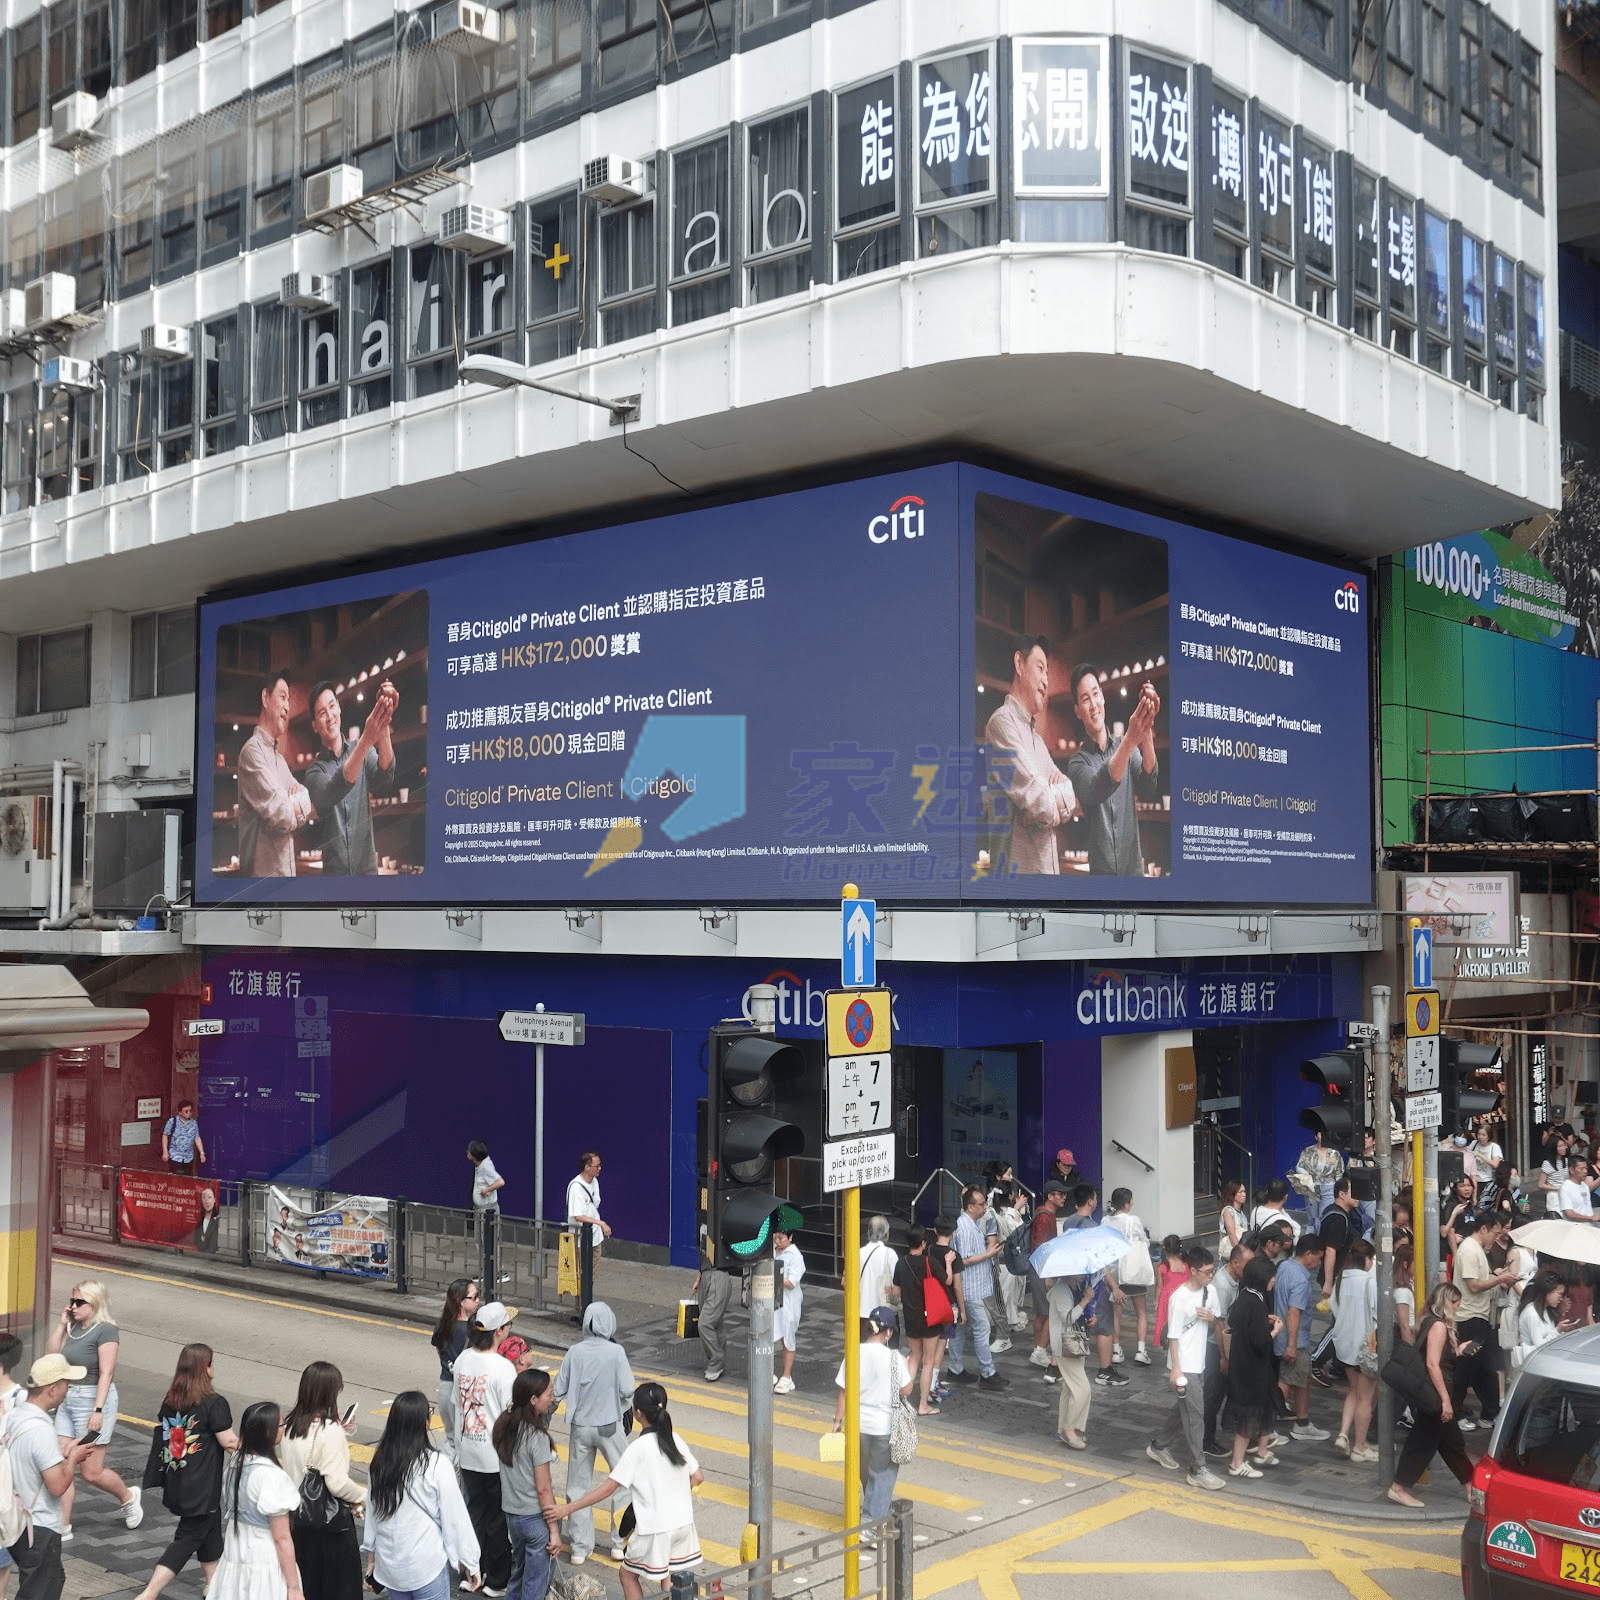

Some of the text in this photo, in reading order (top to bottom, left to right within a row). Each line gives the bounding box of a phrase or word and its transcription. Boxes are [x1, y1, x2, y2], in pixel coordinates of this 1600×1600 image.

[868, 502, 924, 544] citi
[531, 611, 576, 630] Private
[579, 602, 620, 624] Client
[623, 577, 765, 618] 並認購指定投資產品
[1335, 587, 1359, 614] citi
[1493, 589, 1580, 628] Local and International Visitors
[1231, 616, 1257, 634] Private
[1258, 623, 1279, 639] Client
[447, 651, 498, 676] 可享高達
[501, 634, 607, 669] HK$172,000
[1215, 645, 1278, 672] HK$172,000
[614, 692, 664, 714] Private
[667, 687, 713, 707] Client
[1277, 716, 1300, 731] Private
[1301, 719, 1321, 734] Client
[507, 782, 562, 804] Private
[565, 779, 613, 801] Client
[1221, 791, 1251, 806] Private
[1253, 794, 1278, 809] Client
[1491, 961, 1531, 978] JEWELLERY
[228, 969, 302, 999] 花旗銀行
[1076, 975, 1276, 1025] citibank 花旗銀行
[514, 1016, 573, 1028] Humphreys Avenue
[842, 1073, 860, 1088] 上午
[845, 1060, 880, 1084] am 7
[842, 1115, 860, 1129] 下午
[845, 1101, 880, 1125] pm 7
[840, 1140, 879, 1155] Except taxi
[832, 1151, 887, 1170] pick up/drop off
[828, 1164, 891, 1186] 的士上落客除外
[1504, 1523, 1524, 1534] TAXI
[1507, 1531, 1517, 1543] 4
[1497, 1540, 1526, 1552] SEATS
